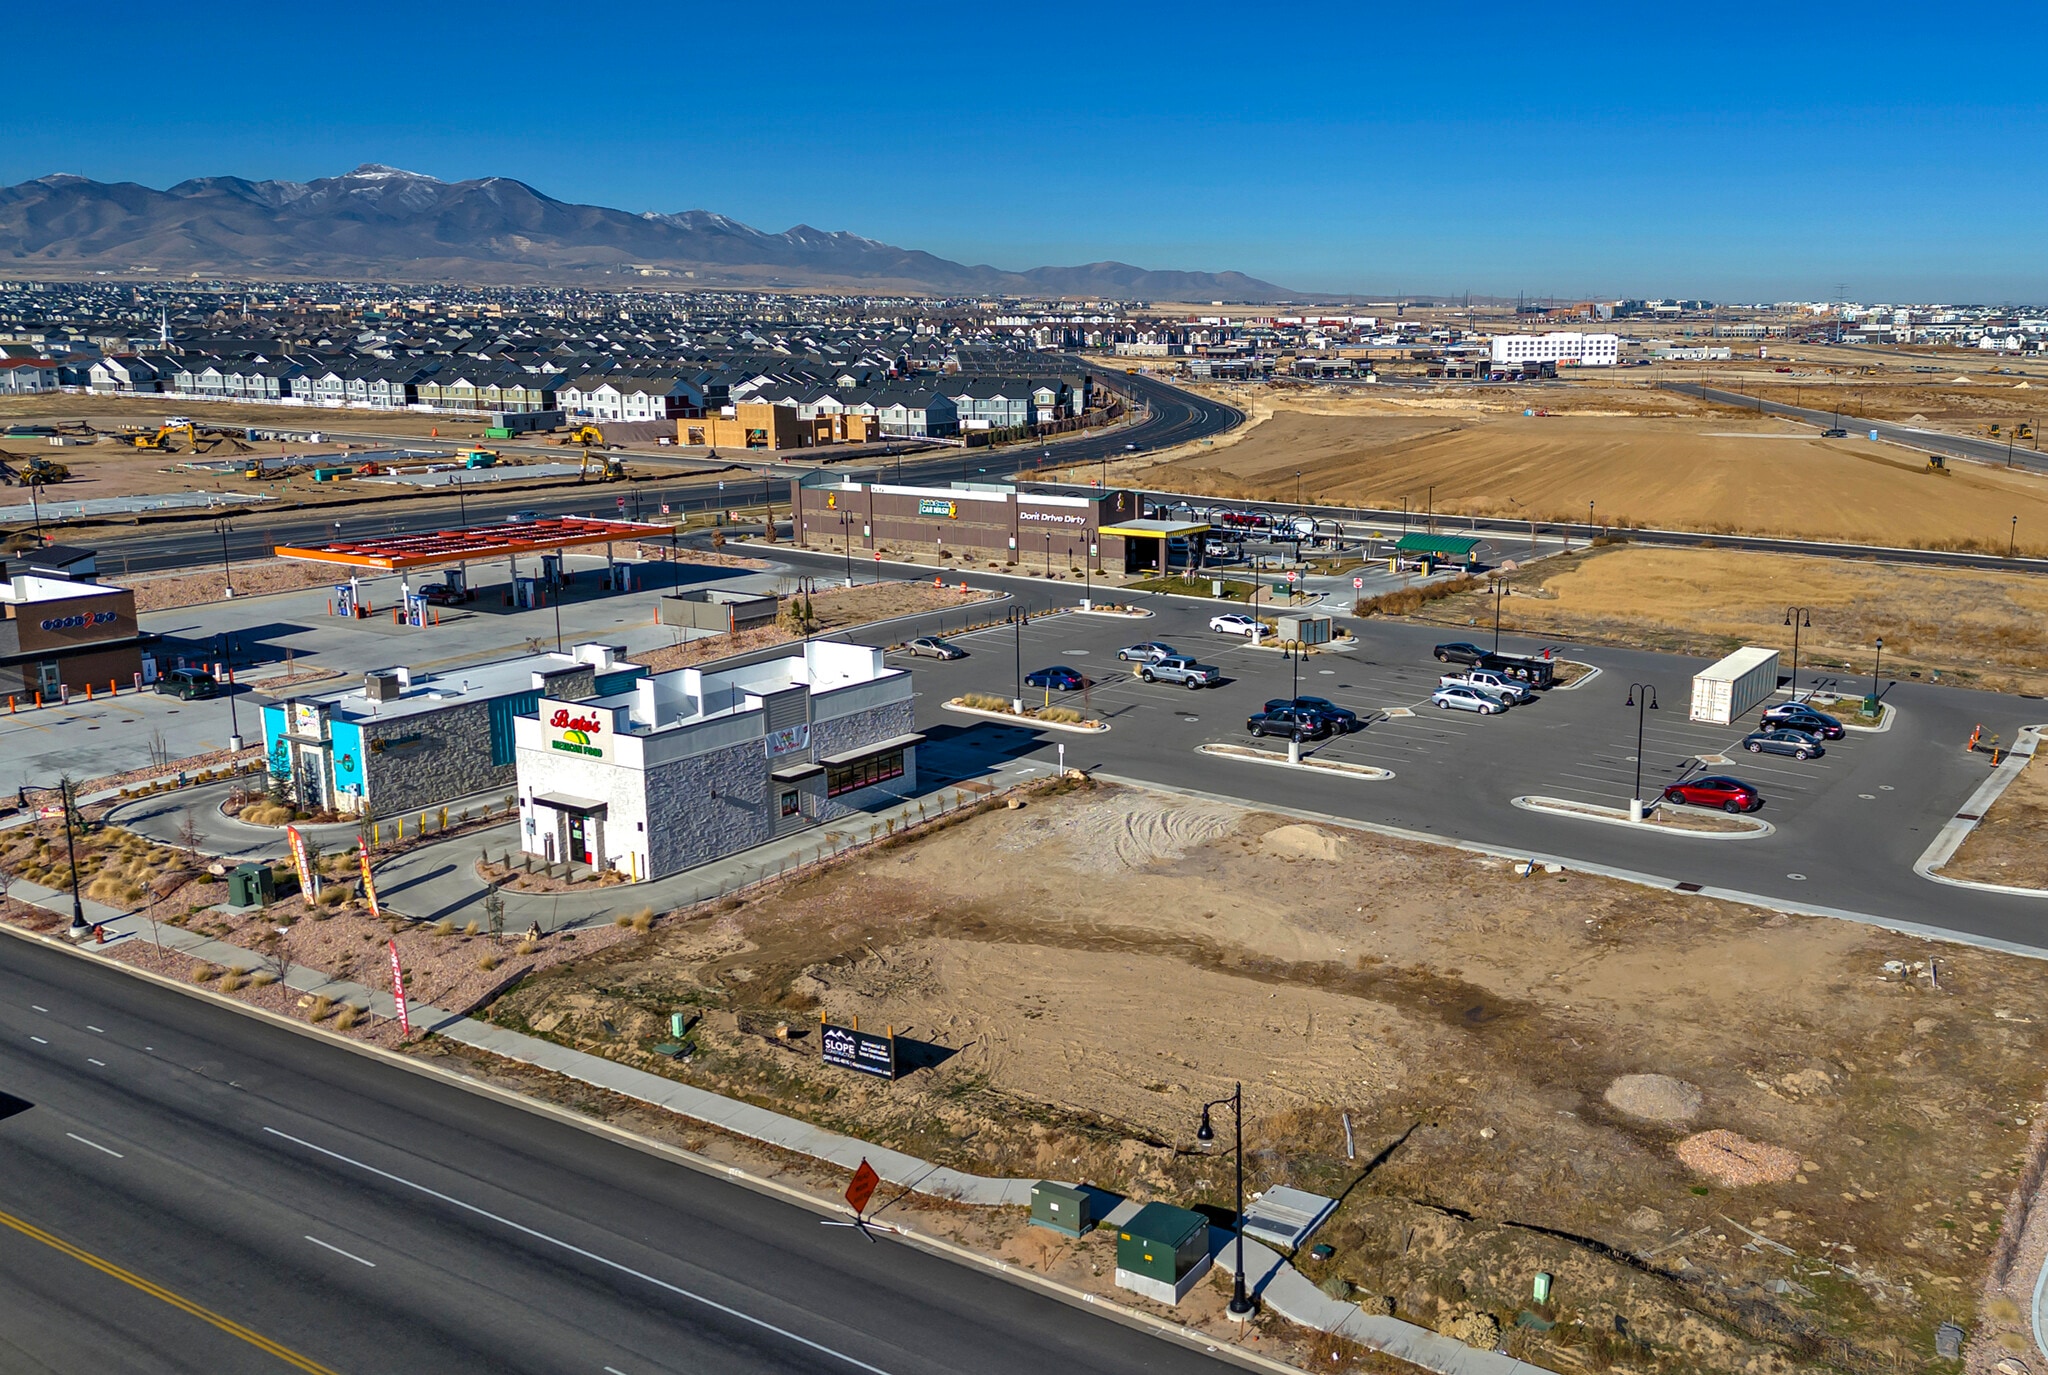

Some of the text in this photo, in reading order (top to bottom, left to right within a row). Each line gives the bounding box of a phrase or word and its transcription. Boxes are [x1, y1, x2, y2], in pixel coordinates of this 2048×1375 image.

[933, 506, 950, 515] WASH
[1041, 513, 1063, 523] Drive
[1064, 515, 1086, 525] Dirty
[550, 709, 601, 733] Beto's
[552, 740, 603, 757] MEXICAN FOOD
[825, 1039, 855, 1054] SLOPE
